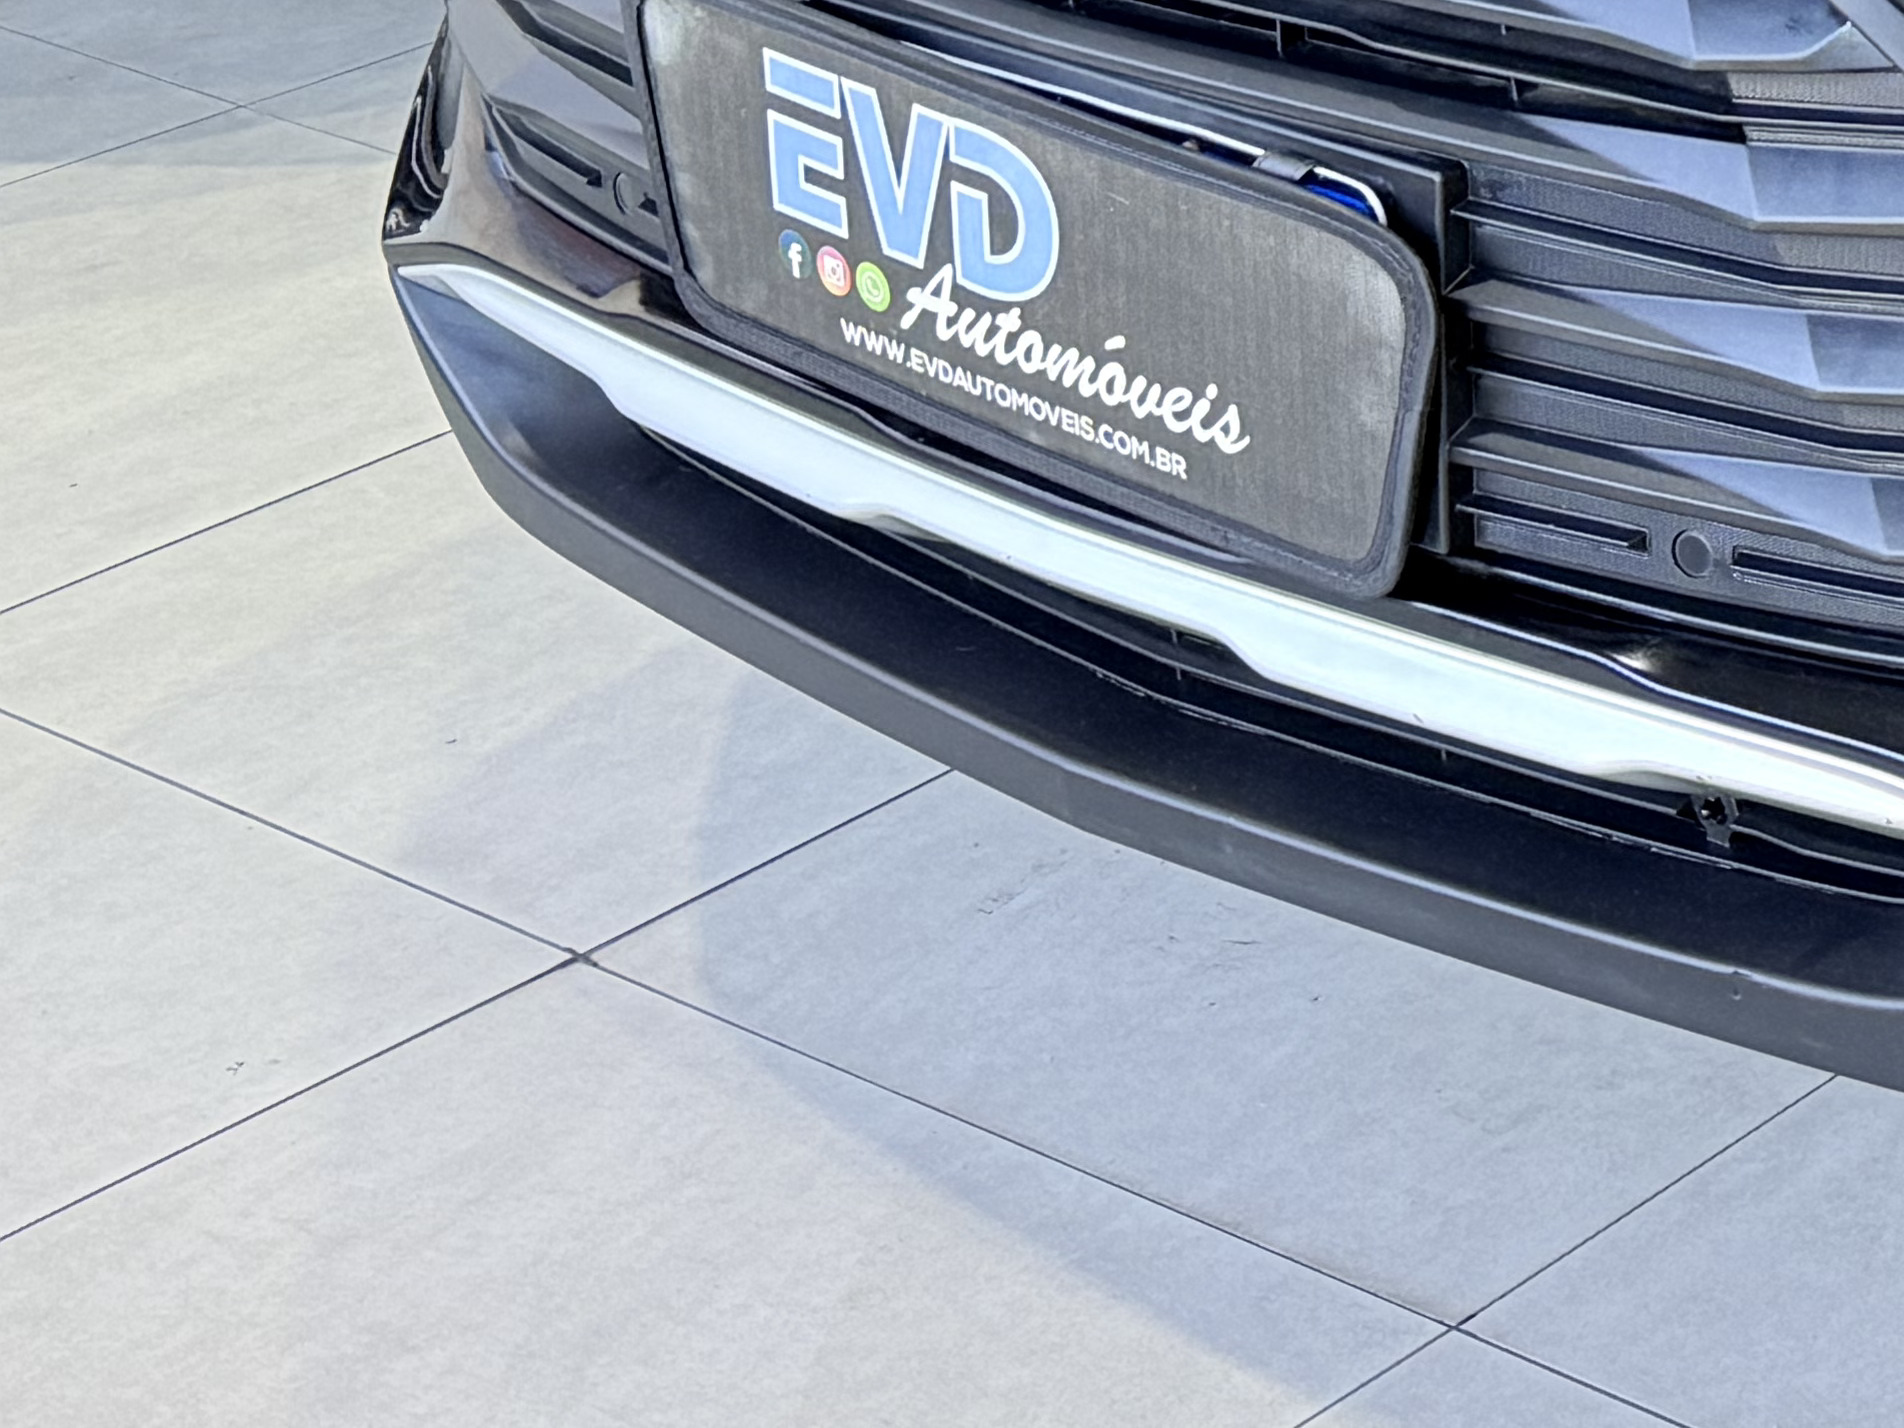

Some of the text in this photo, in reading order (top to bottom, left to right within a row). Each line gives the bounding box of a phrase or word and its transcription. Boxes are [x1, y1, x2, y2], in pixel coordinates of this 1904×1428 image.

[762, 47, 1059, 303] EVD
[840, 317, 1188, 481] WWW.EVDAUTOMOVEIS.COM.BR
[901, 263, 1251, 456] Automóveis
